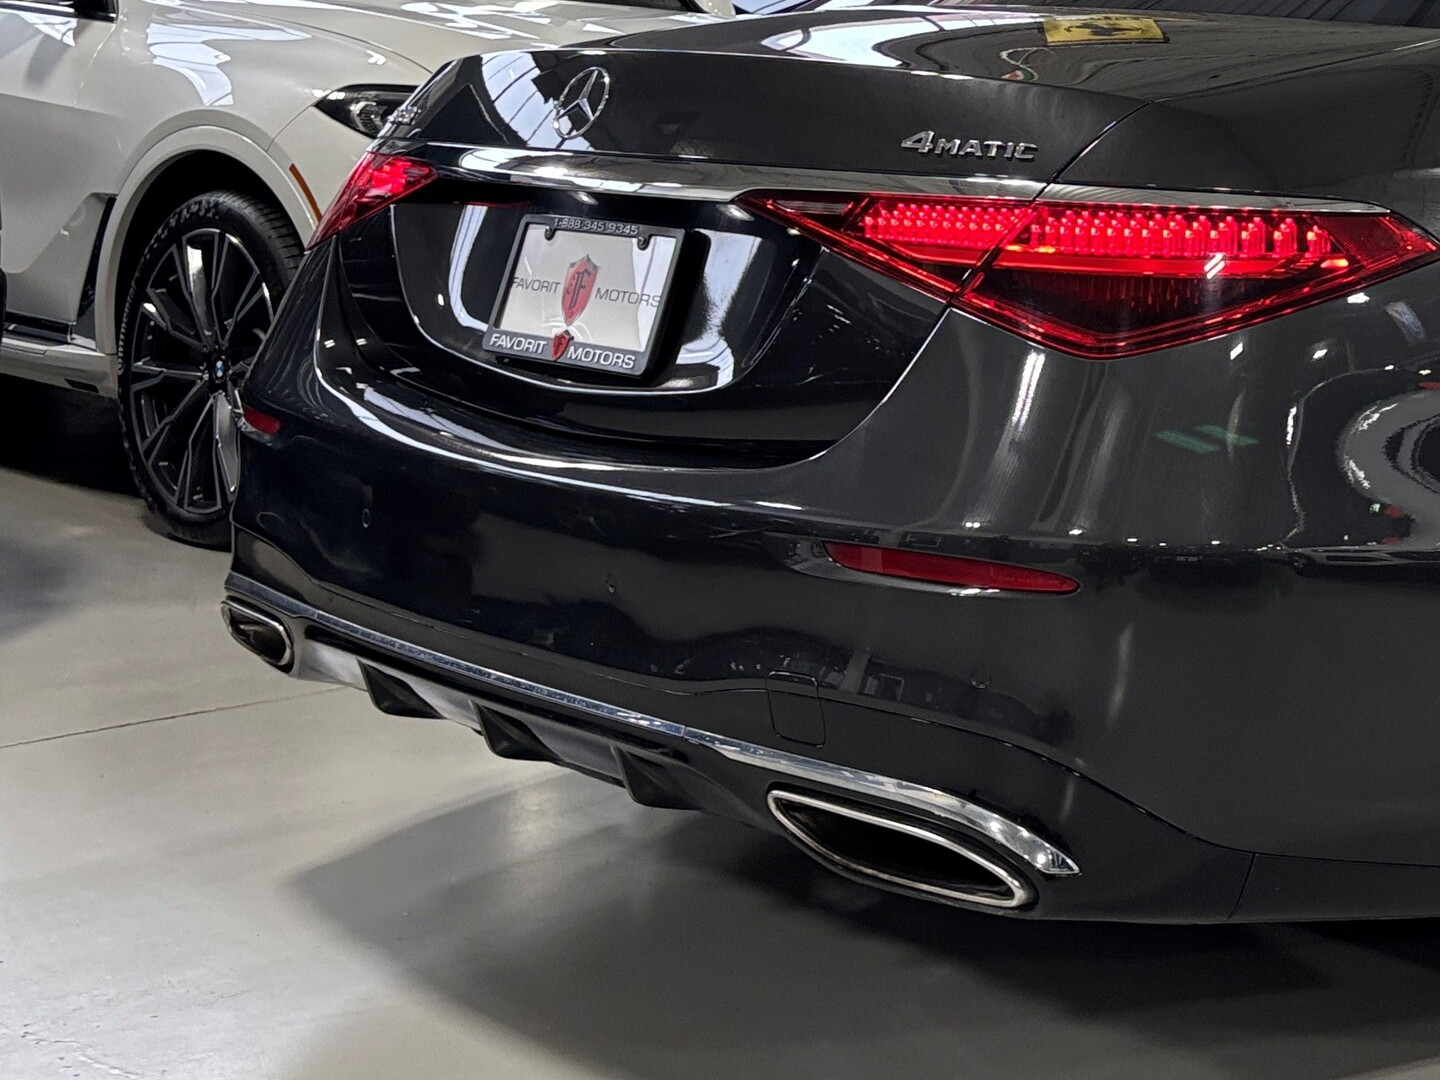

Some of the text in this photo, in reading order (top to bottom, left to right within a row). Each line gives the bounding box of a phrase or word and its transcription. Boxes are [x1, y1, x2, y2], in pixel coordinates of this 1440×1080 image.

[901, 130, 1038, 160] 4MATIC
[511, 277, 662, 308] FAVORIT MOTORS
[489, 333, 636, 369] FAVORIT MOTORS
